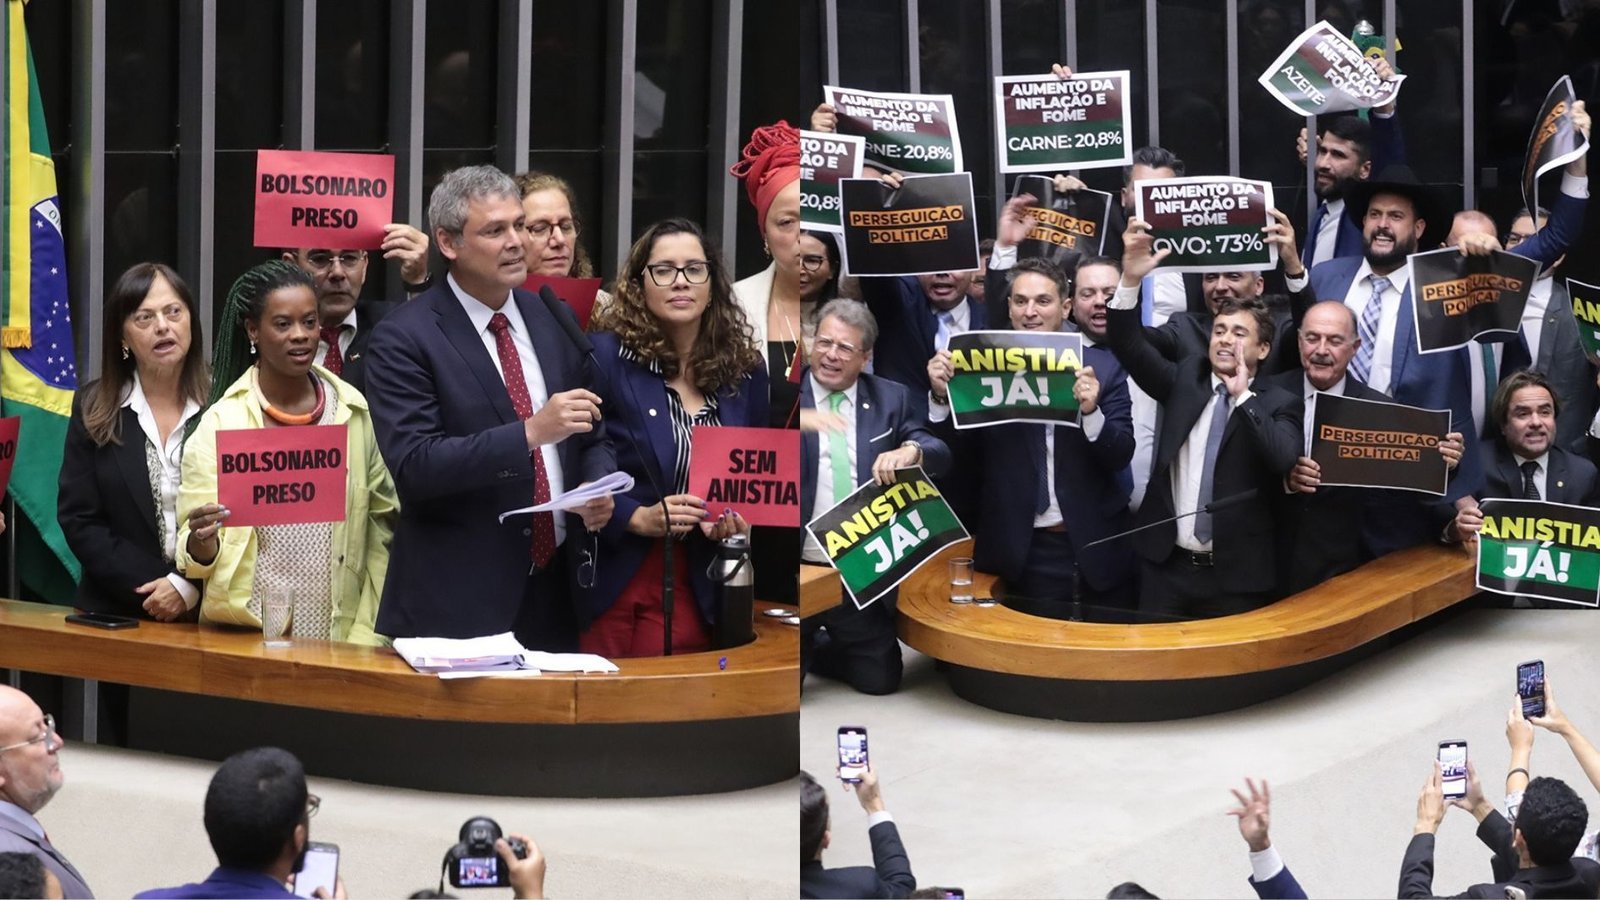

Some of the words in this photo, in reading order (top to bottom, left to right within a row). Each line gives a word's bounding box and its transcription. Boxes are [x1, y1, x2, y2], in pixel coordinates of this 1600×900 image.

[1322, 34, 1382, 85] AUMENTO
[1010, 80, 1088, 97] AUMENTO
[1090, 79, 1115, 92] DA
[840, 94, 913, 112] AUMENTO
[915, 100, 940, 113] DA
[1015, 92, 1094, 110] INFLAÇÃO
[1096, 93, 1107, 105] E
[846, 106, 921, 124] INFLAÇÃO
[923, 114, 933, 124] E
[1042, 108, 1087, 123] FOME
[873, 120, 916, 133] FOME
[823, 141, 848, 156] DA
[865, 142, 901, 158] RNE:
[904, 145, 953, 162] 20,8%
[1008, 134, 1072, 152] CARNE:
[1074, 131, 1123, 149] 20,8%
[827, 156, 839, 169] E
[261, 173, 388, 198] BOLSONARO
[1150, 183, 1230, 200] AUMENTO
[1232, 183, 1257, 195] DA
[1154, 195, 1235, 214] INFLAÇÃO
[1238, 197, 1249, 209] E
[291, 207, 358, 229] PRESO
[852, 206, 963, 225] PERSEGUIÇÃO
[1182, 212, 1228, 227] FOME
[1153, 236, 1212, 255] OVO:
[1215, 233, 1263, 254] 73%
[951, 347, 1083, 372] ANISTIA
[980, 370, 1051, 407] JÁ!
[1323, 427, 1439, 447] PERSEGUIÇÃO
[221, 448, 342, 474] BOLSONARO
[728, 448, 777, 475] SEM
[253, 482, 316, 505] PRESO
[706, 478, 799, 506] ANISTIA
[825, 480, 941, 559] ANISTIA
[864, 509, 930, 573] JÁ!
[1480, 516, 1600, 550] ANISTIA
[1502, 541, 1571, 583] JÁ!
